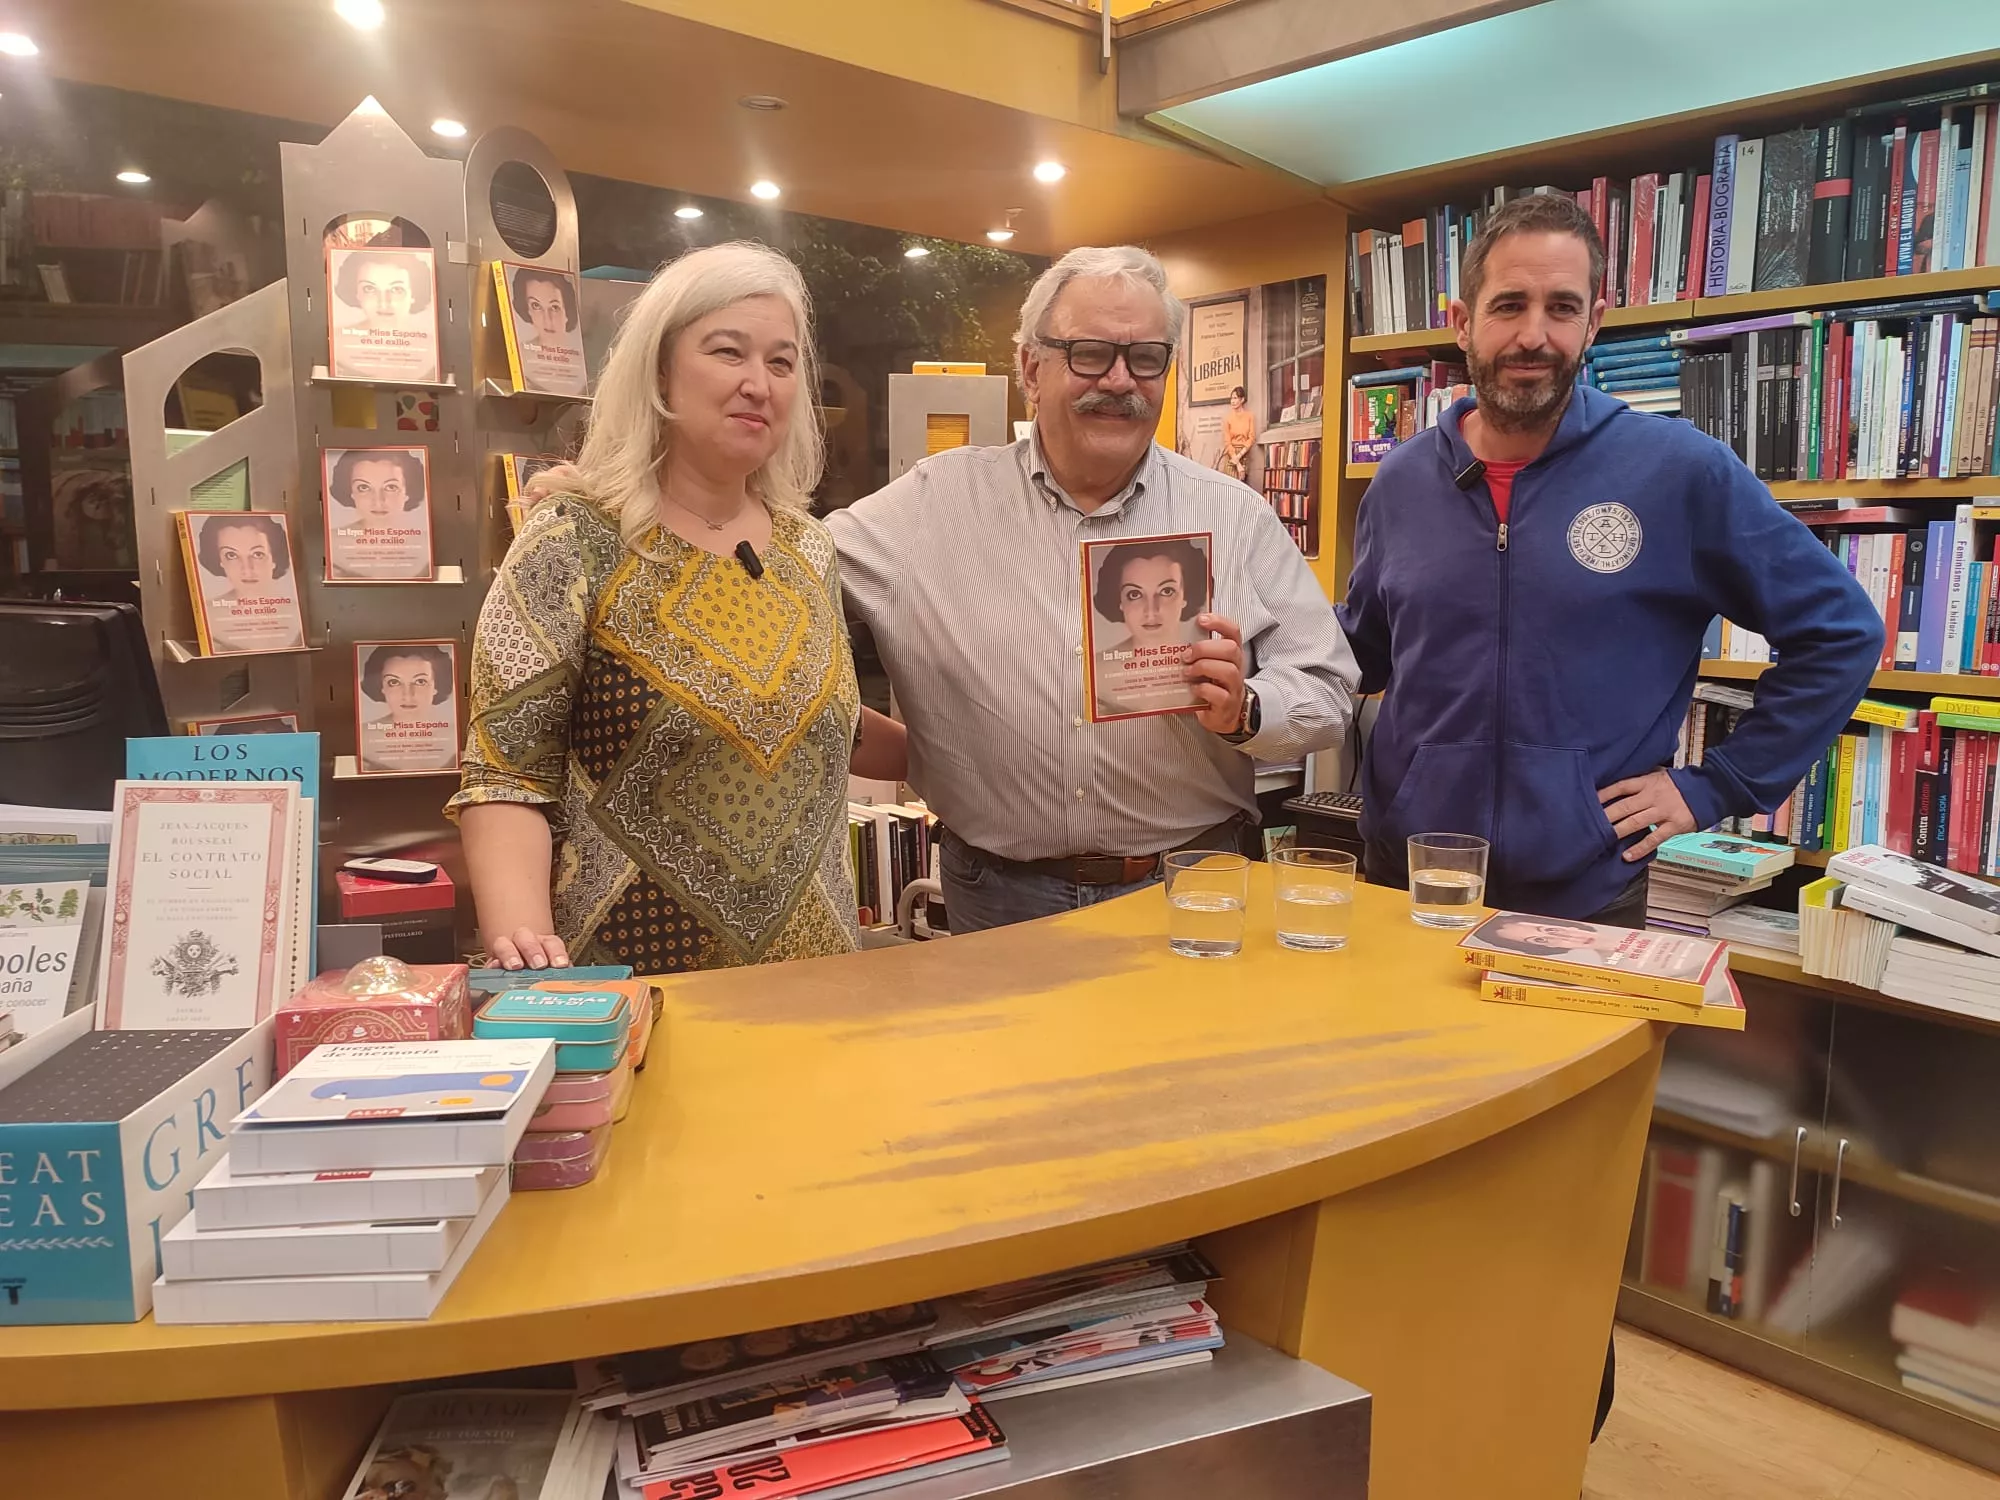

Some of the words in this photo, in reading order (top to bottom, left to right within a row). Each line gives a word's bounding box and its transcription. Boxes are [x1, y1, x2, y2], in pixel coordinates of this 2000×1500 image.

[1709, 143, 1732, 288] HISTORIA-BIOGRAFÍA
[1194, 351, 1241, 382] LIBRERÍA
[1952, 541, 1968, 592] Feminismos
[1134, 647, 1158, 657] Miss
[1124, 662, 1137, 670] en
[1139, 659, 1149, 668] el
[1152, 657, 1180, 667] exilio
[1945, 702, 1981, 715] DYER
[193, 743, 248, 761] LOS
[160, 822, 249, 831] JEAN-JACQUES
[141, 852, 163, 863] EL
[170, 852, 262, 863] CONTRATO
[168, 868, 233, 880] SOCIAL
[350, 1048, 440, 1059] memoria
[352, 1107, 402, 1117] ALMA
